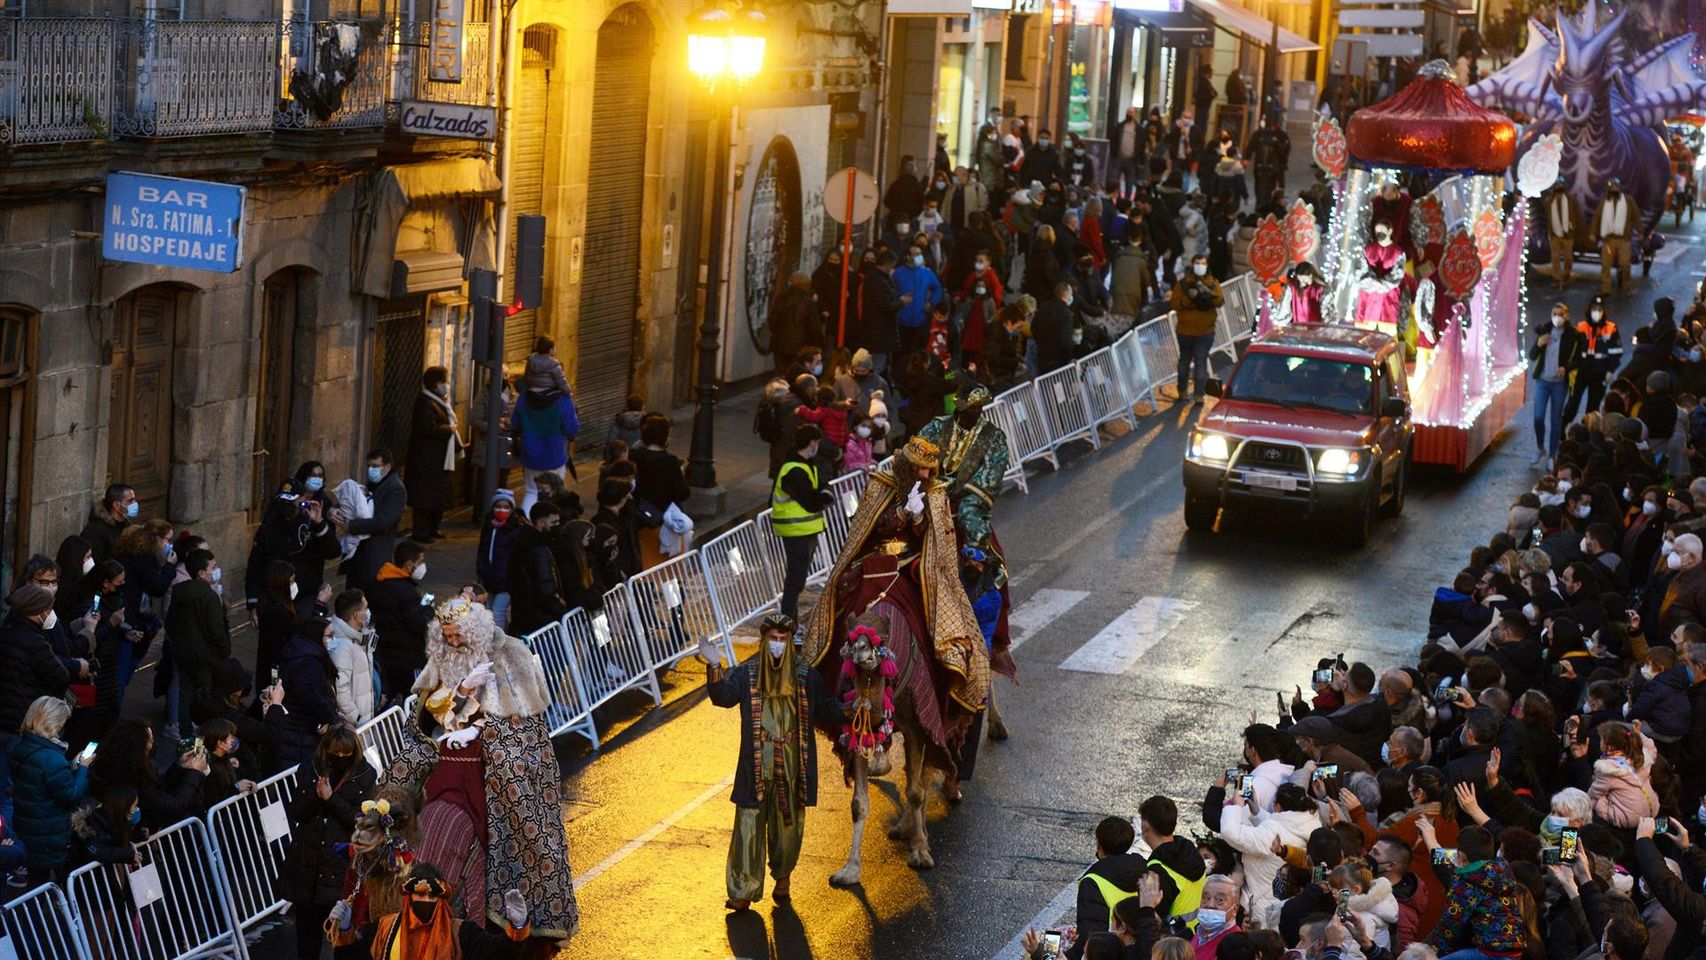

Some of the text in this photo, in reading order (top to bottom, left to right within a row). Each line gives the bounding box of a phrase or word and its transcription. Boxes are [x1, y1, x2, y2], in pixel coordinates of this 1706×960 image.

[403, 107, 488, 136] Calzados
[138, 186, 208, 208] BAR
[112, 204, 125, 226] N.
[130, 207, 158, 230] Sra.
[163, 210, 213, 236] FATIMA
[226, 217, 233, 238] 1
[113, 232, 227, 262] HOSPEDAJE
